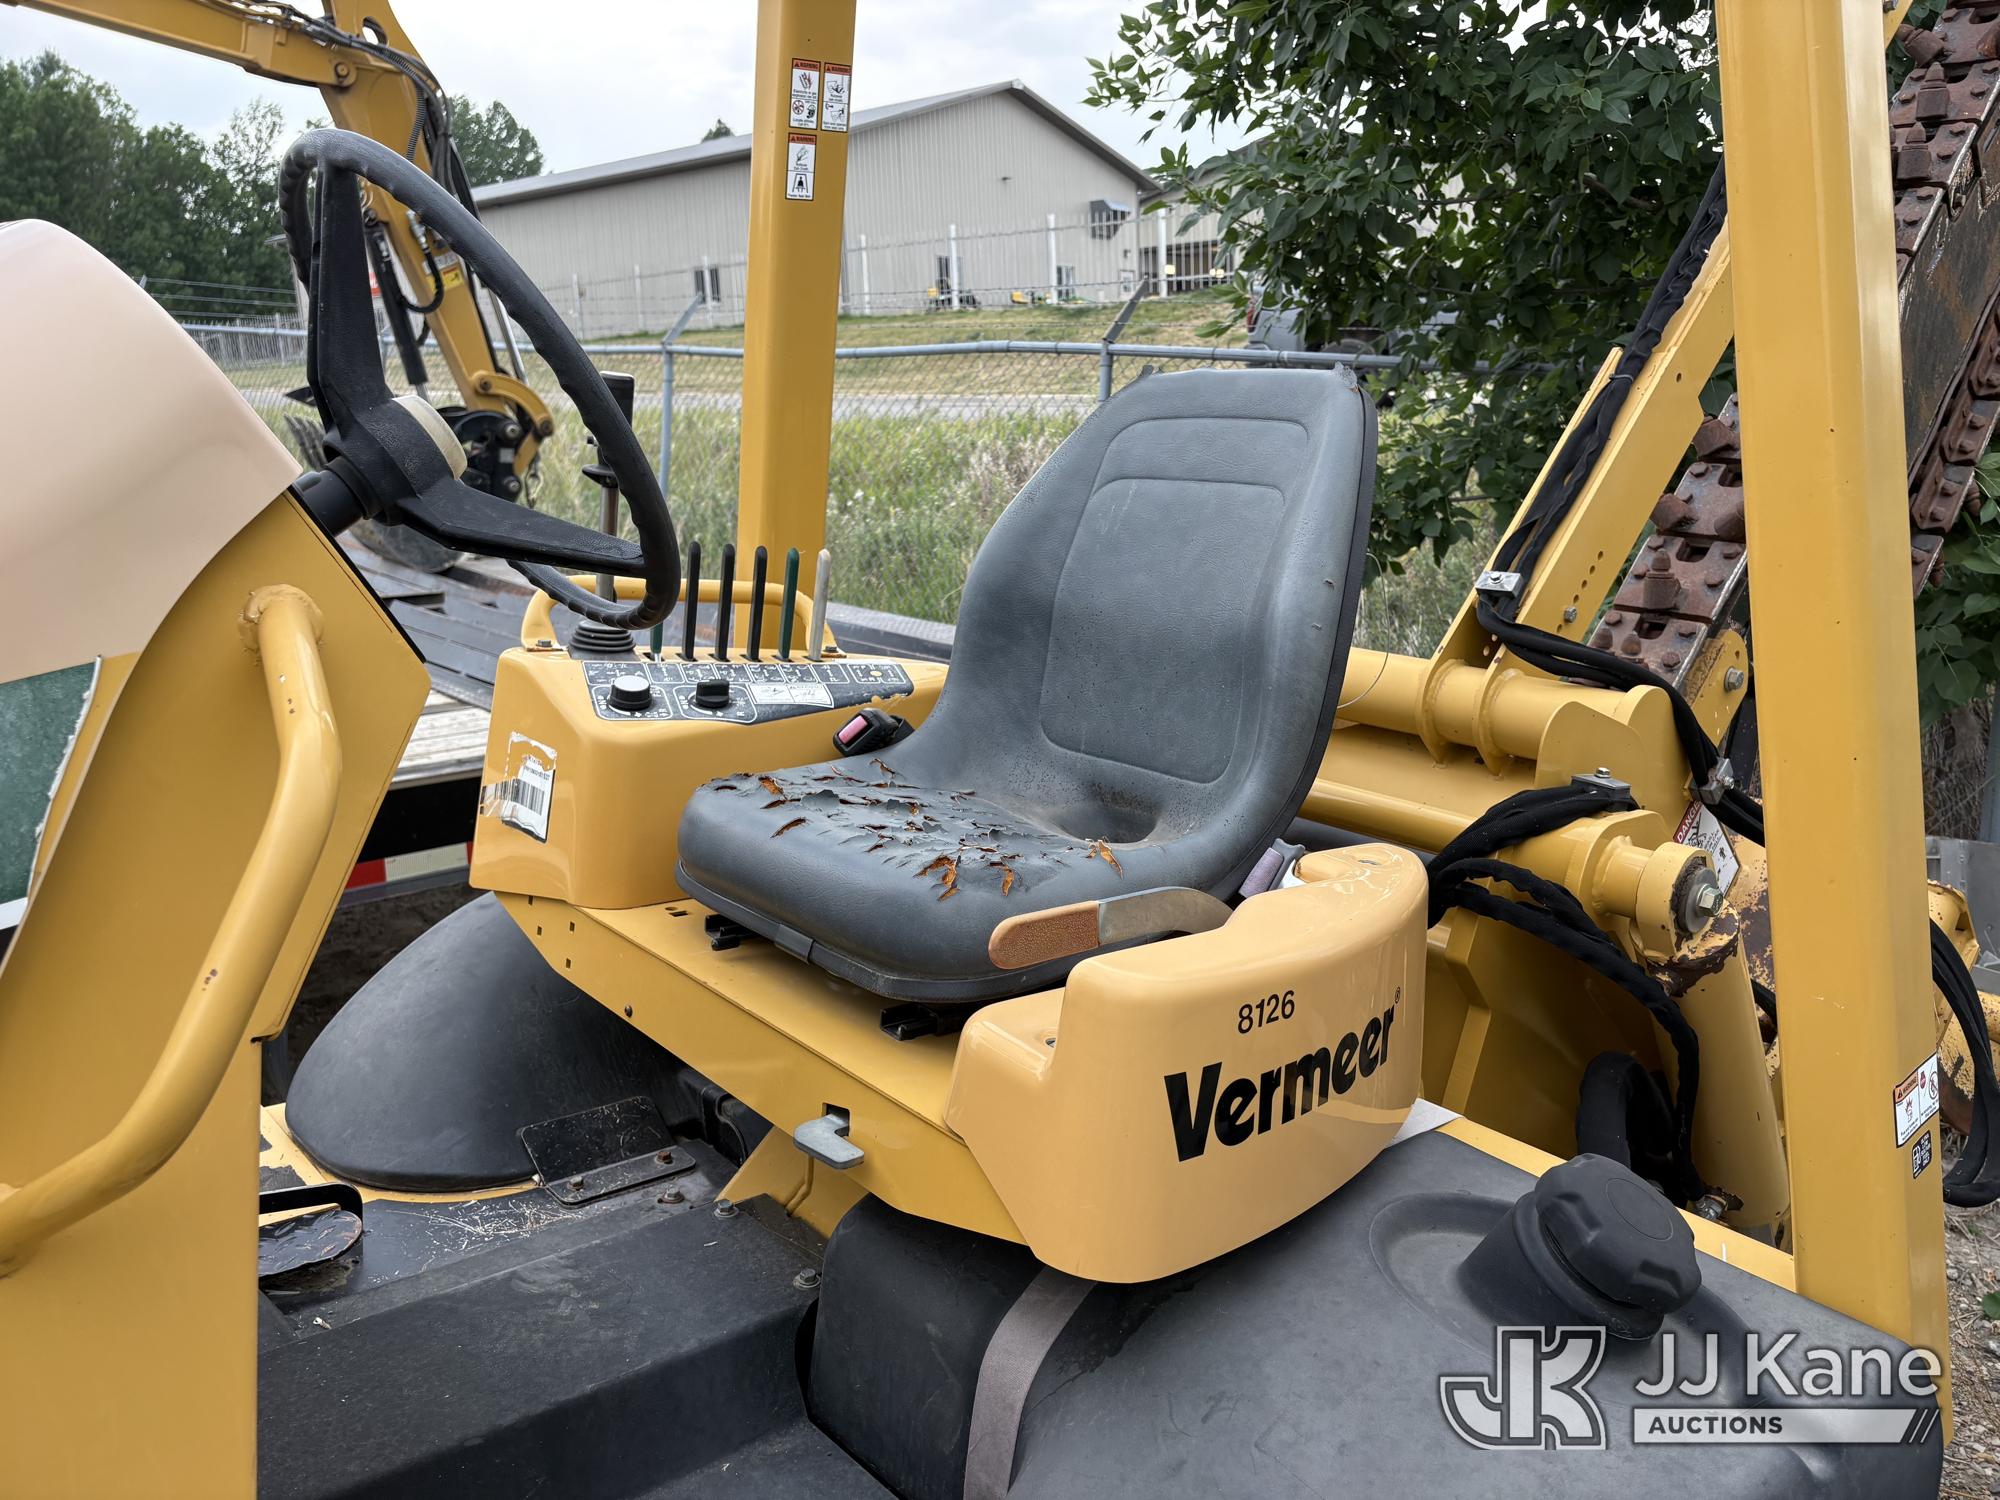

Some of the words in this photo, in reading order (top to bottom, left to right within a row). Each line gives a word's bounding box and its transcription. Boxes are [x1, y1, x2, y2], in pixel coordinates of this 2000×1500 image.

[1677, 800, 1700, 842] DANGE
[1237, 990, 1295, 1034] 8126
[1164, 1004, 1395, 1162] Vermeer
